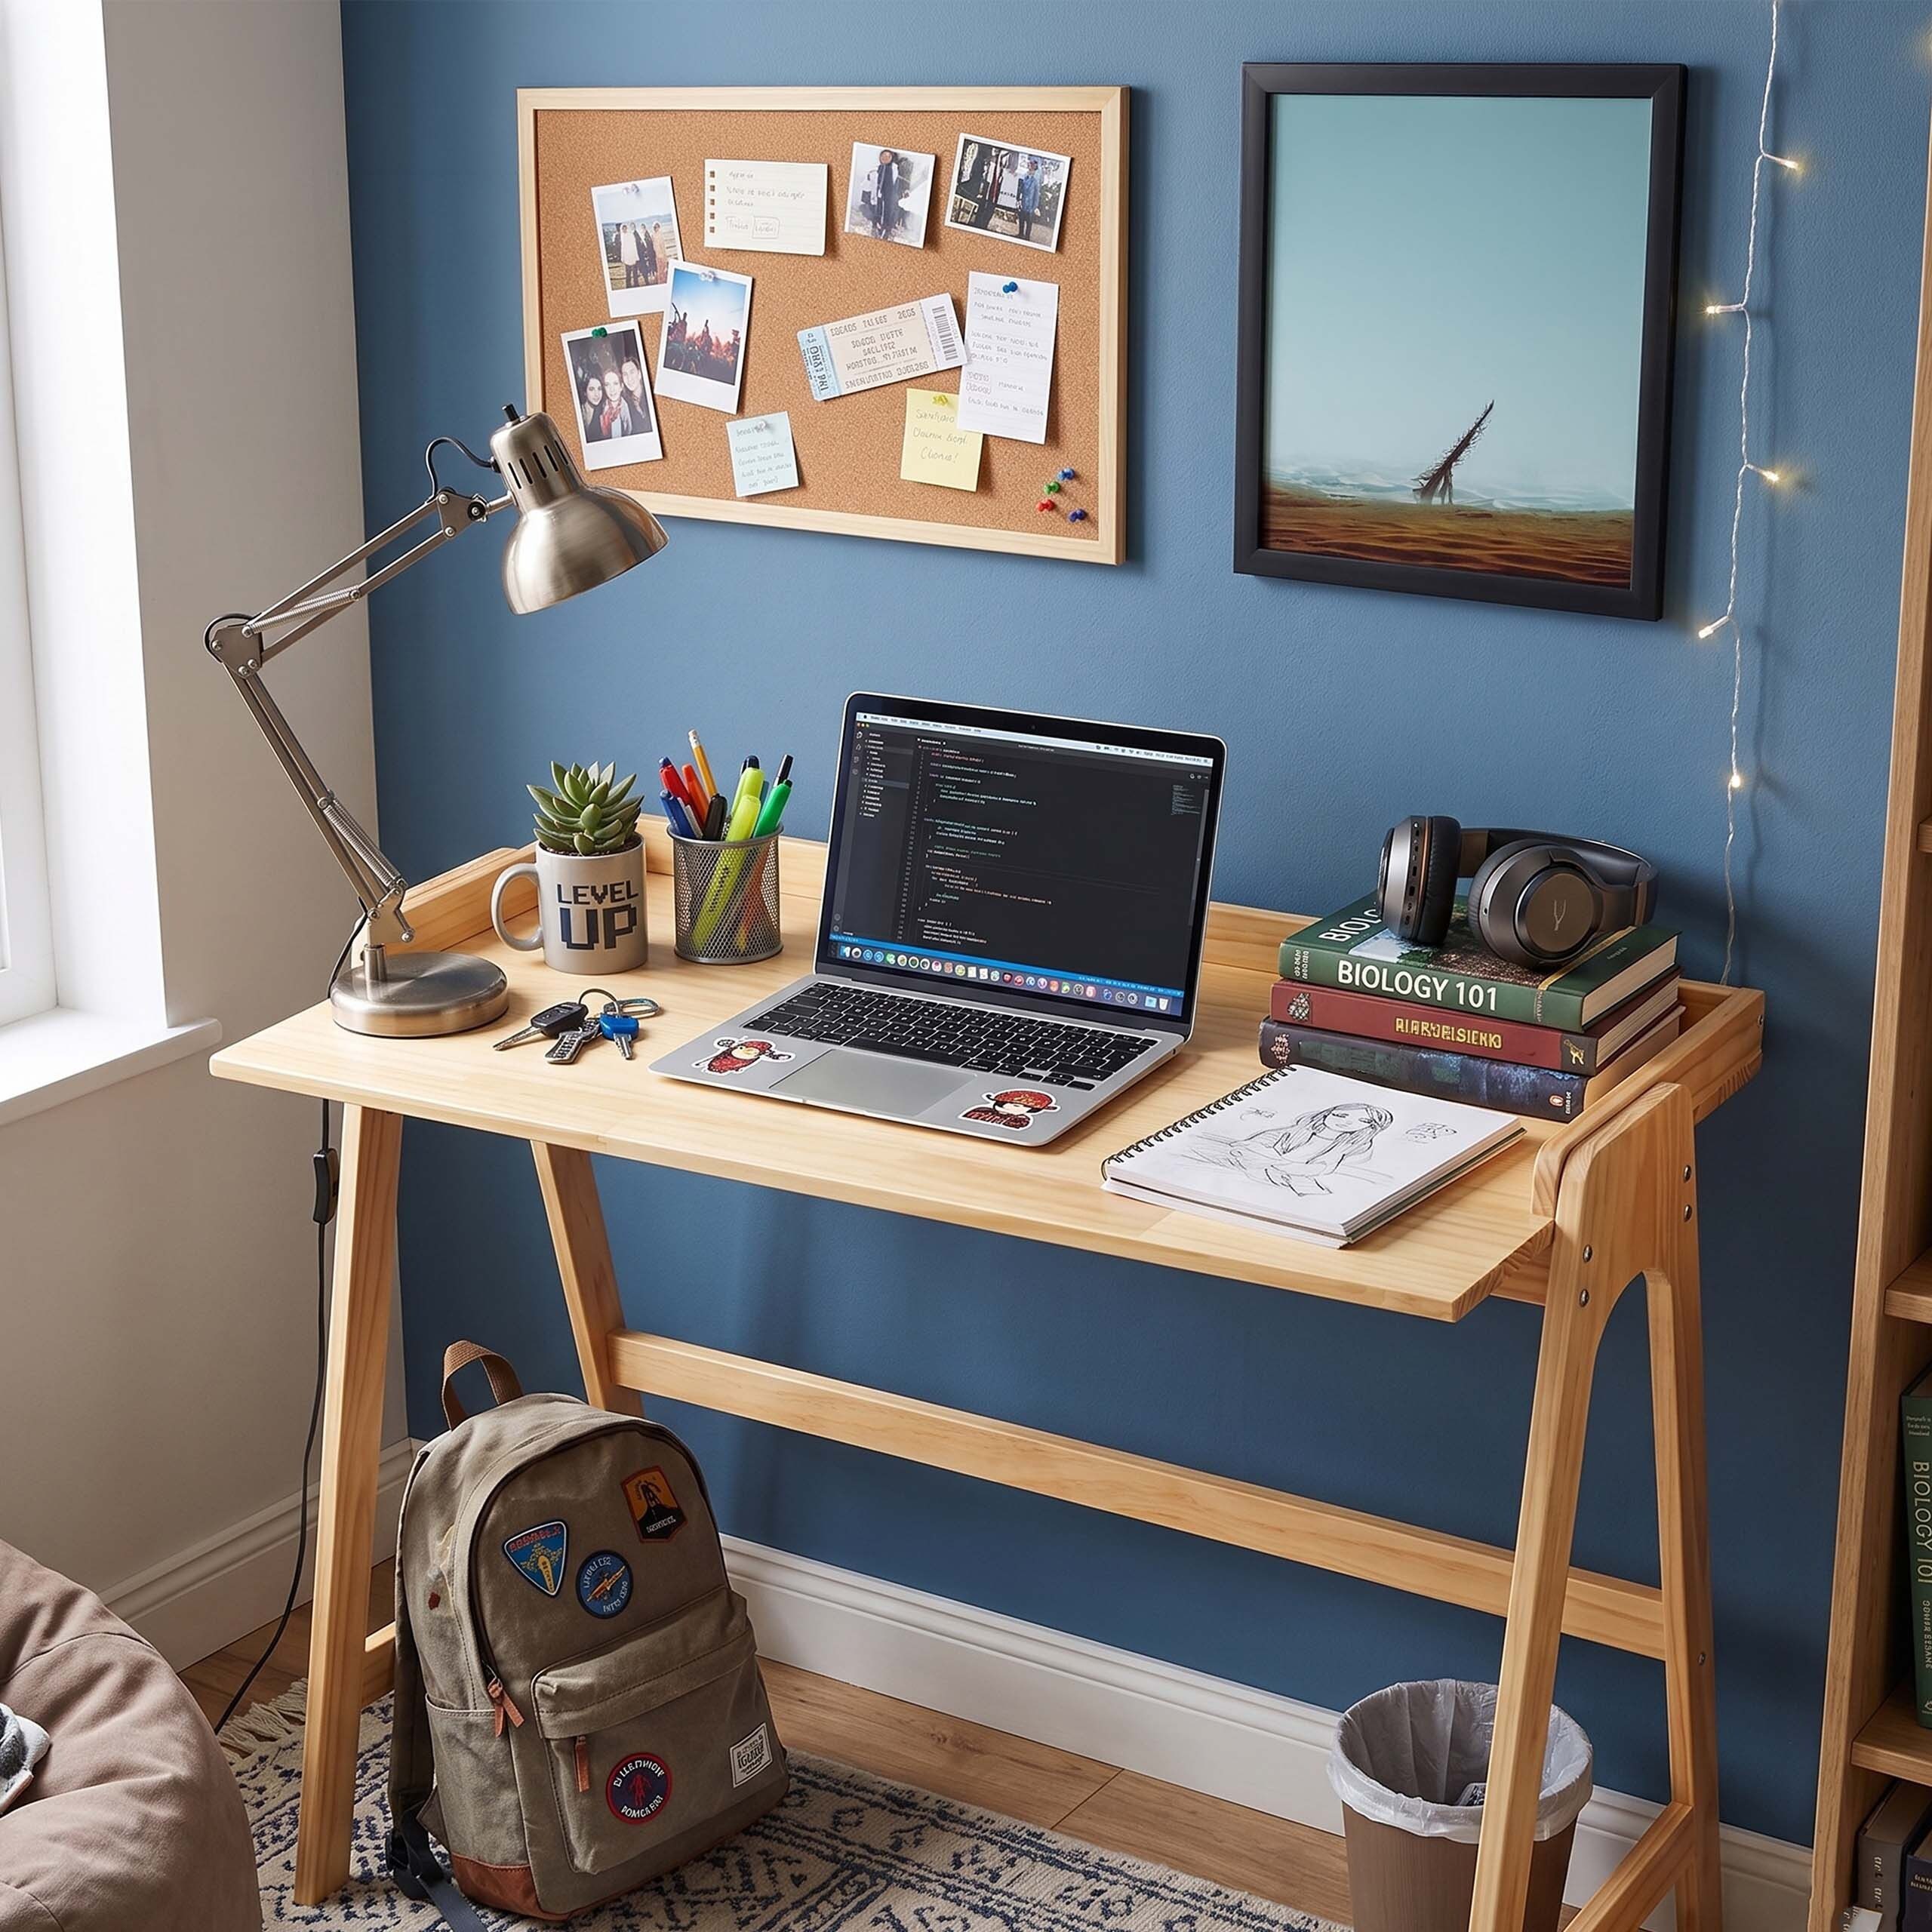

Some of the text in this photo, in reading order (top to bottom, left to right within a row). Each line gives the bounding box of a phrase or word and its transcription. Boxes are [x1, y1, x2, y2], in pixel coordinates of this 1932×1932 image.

[558, 880, 638, 905] LEVEL
[559, 905, 637, 950] UP
[1337, 959, 1448, 1001] BIOLOGY
[1456, 980, 1497, 1011] 101
[1912, 1460, 1932, 1551] BIOLOGY
